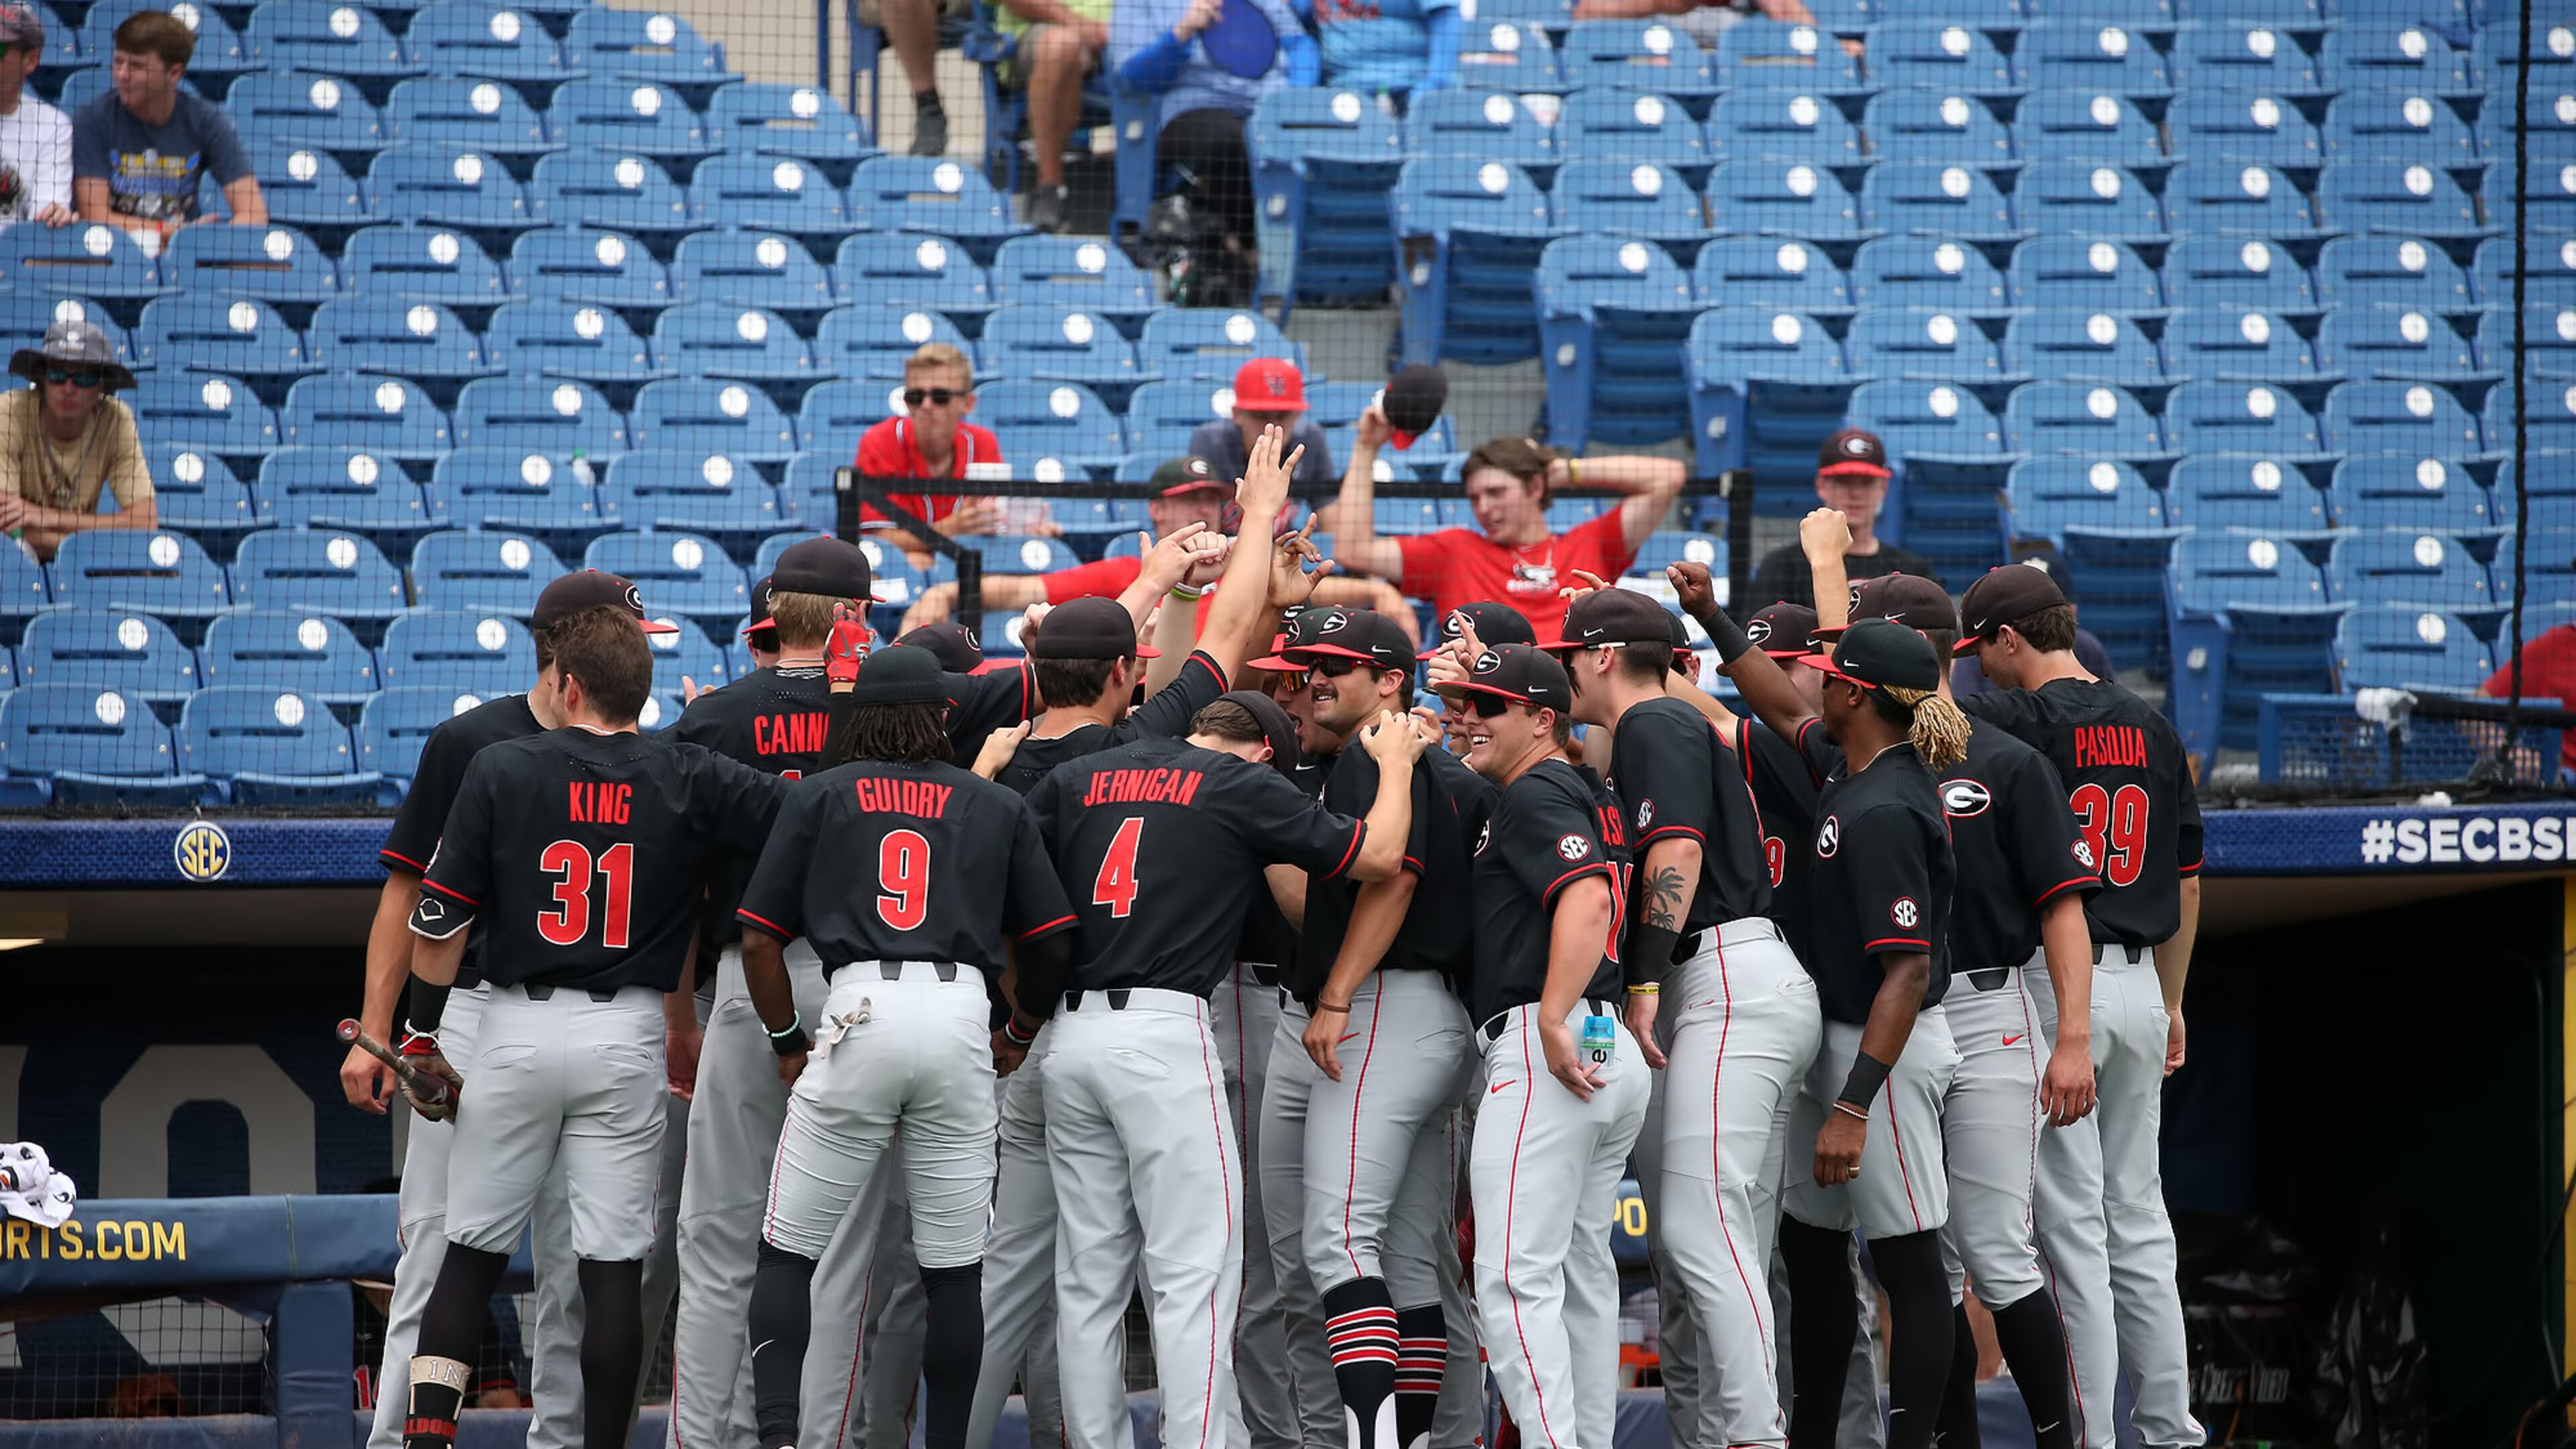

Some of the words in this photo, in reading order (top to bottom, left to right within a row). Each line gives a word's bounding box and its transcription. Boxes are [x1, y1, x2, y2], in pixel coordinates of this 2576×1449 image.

[754, 712, 830, 756] CANN
[2074, 725, 2147, 769] PASQUA
[569, 781, 633, 825] KING
[856, 777, 953, 820] GUIDRY
[1084, 768, 1204, 807] JERNIGAN
[181, 828, 225, 877] SEC
[1560, 835, 1589, 860] SEC
[2070, 782, 2150, 888] 39
[876, 828, 931, 932] 9
[1091, 816, 1146, 919] 4
[537, 839, 634, 949] 31
[1894, 899, 1919, 929] SEC
